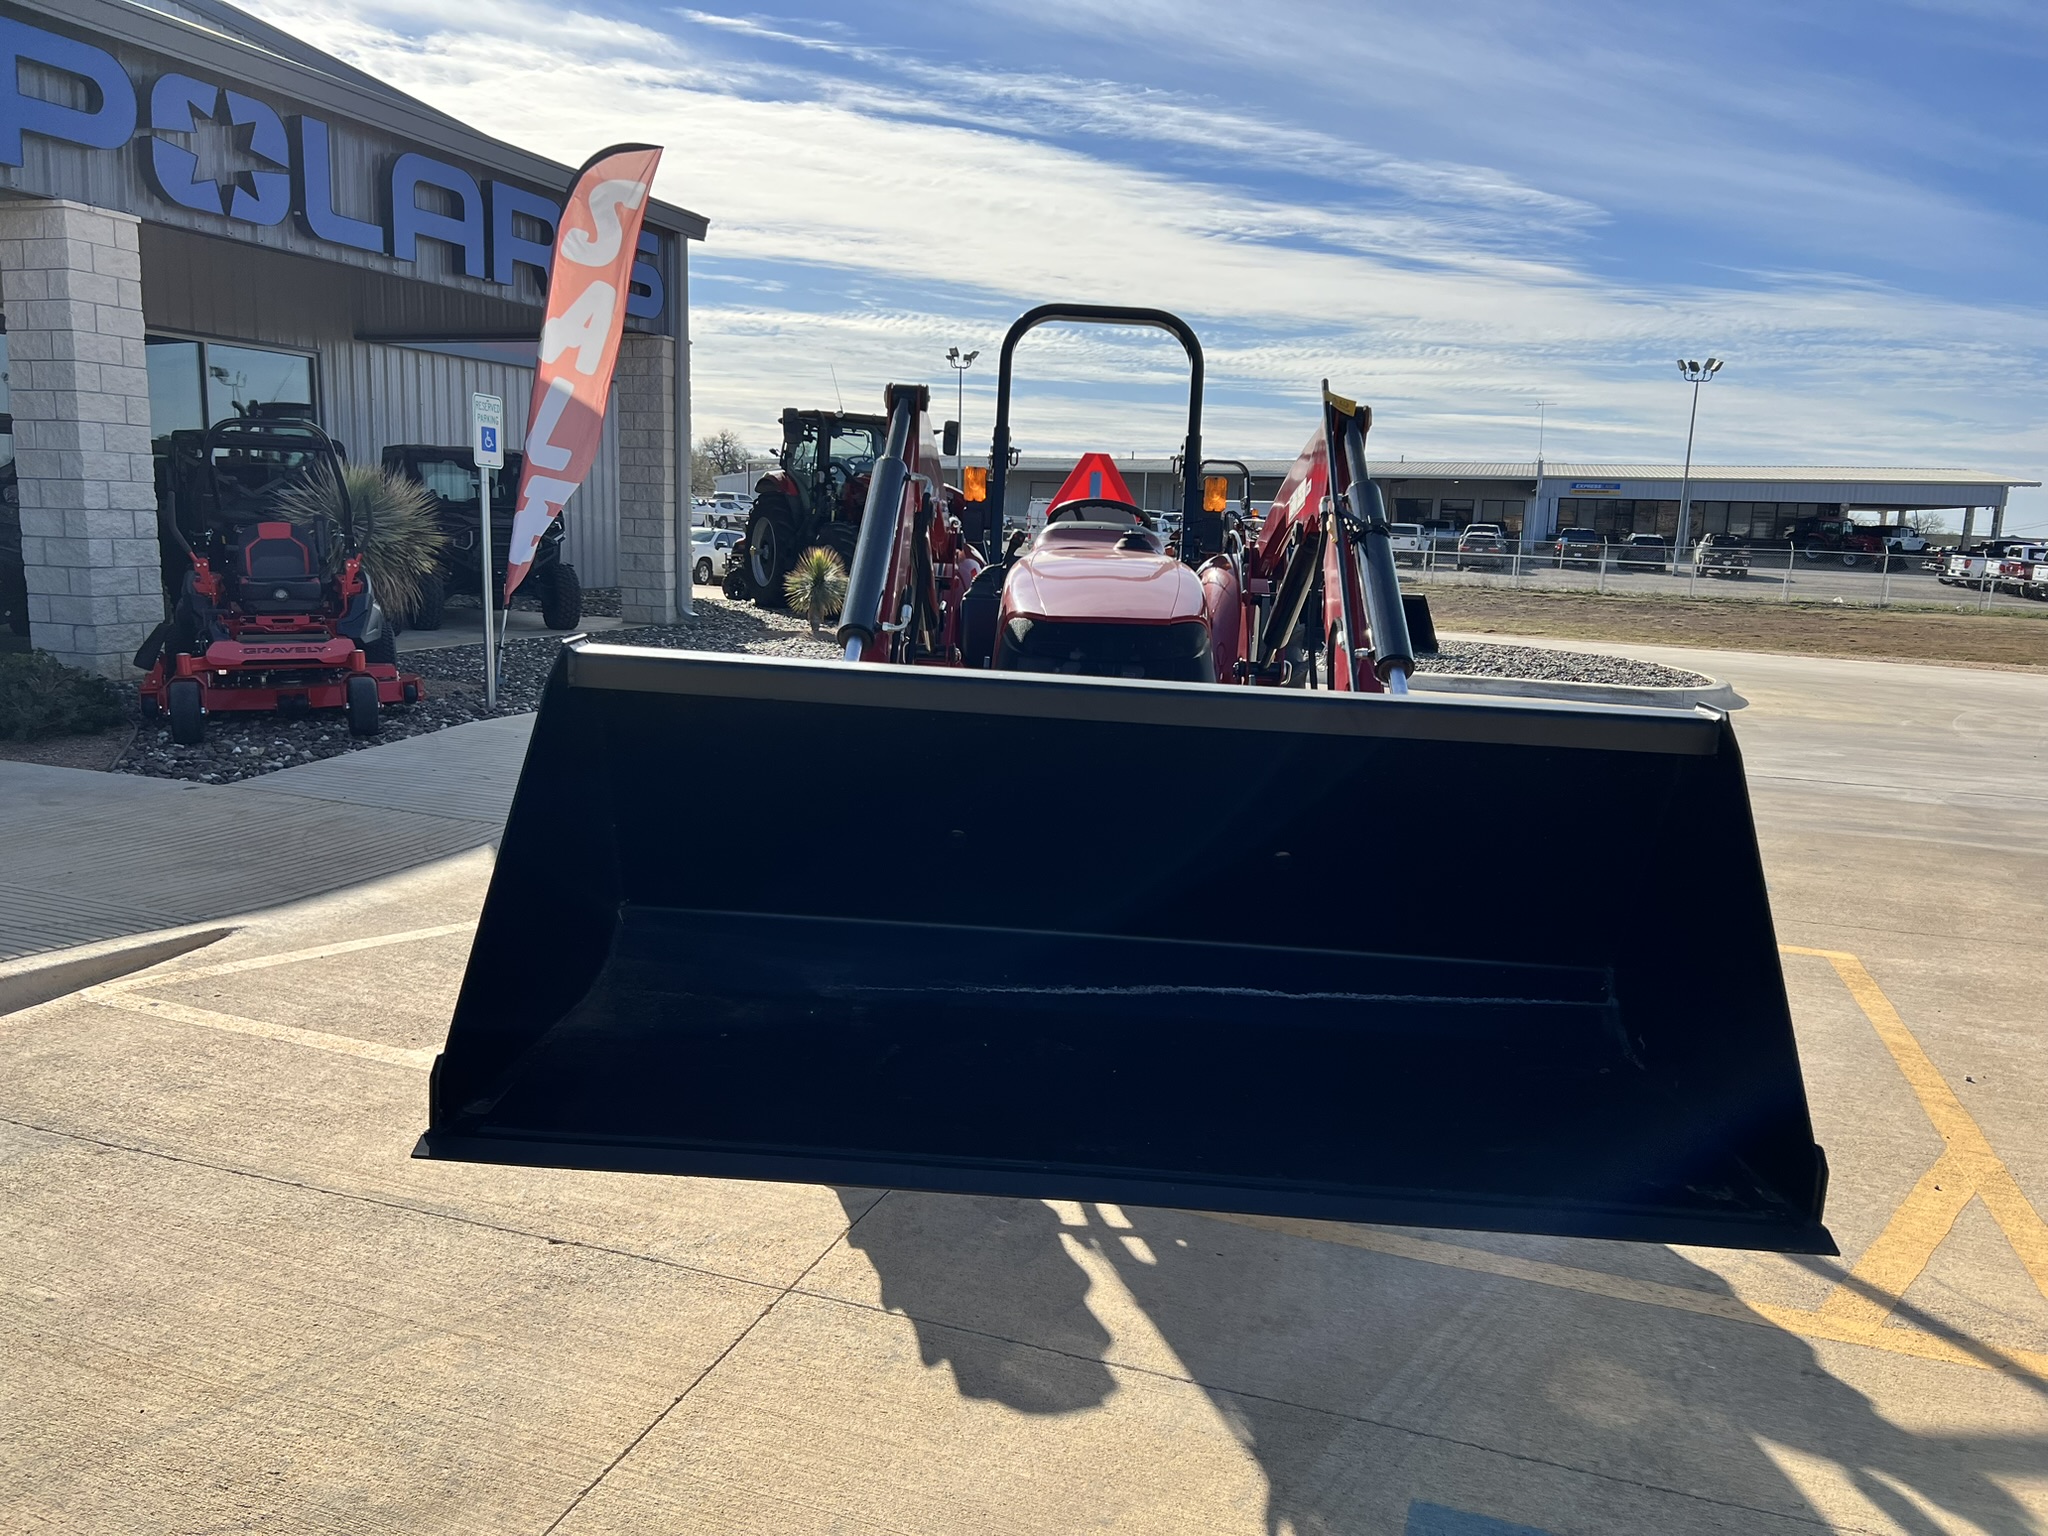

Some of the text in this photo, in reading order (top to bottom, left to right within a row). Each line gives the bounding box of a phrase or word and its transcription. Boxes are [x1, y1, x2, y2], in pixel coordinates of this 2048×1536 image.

[0, 16, 664, 319] POLARS
[508, 179, 647, 565] SALE
[475, 401, 500, 414] RESERVED
[477, 413, 499, 426] PARKING
[243, 646, 327, 655] GRAVELY
